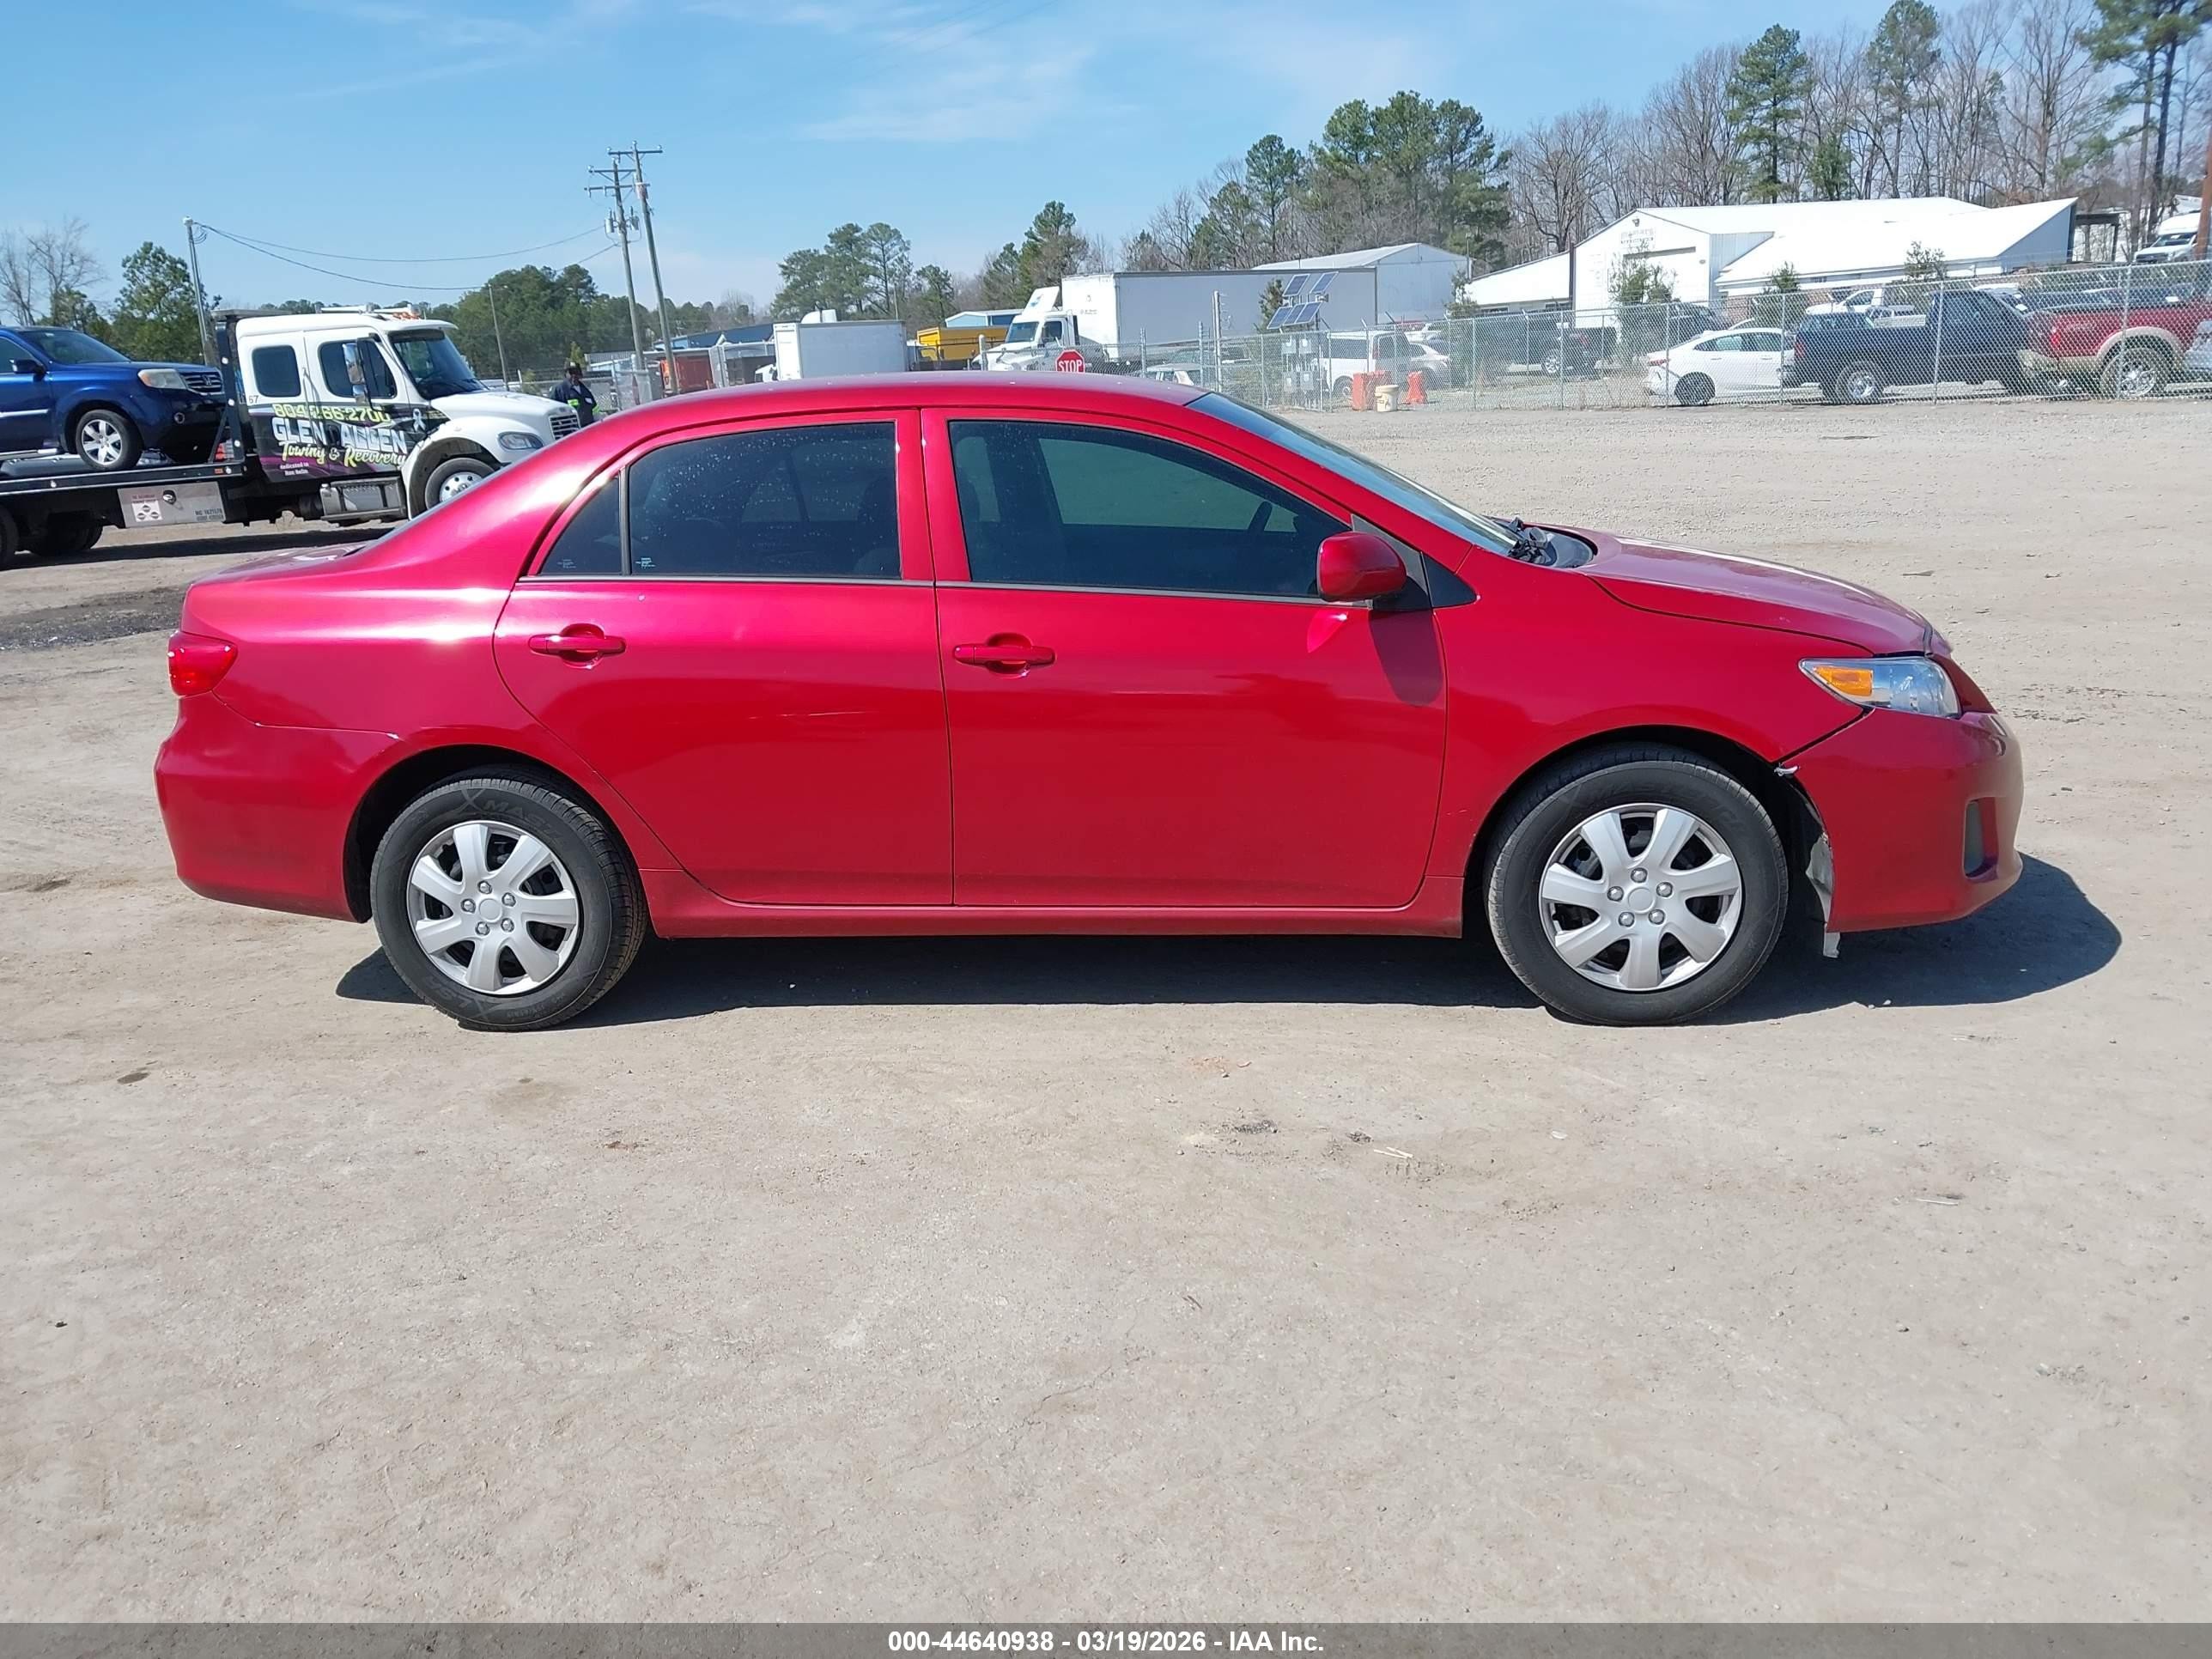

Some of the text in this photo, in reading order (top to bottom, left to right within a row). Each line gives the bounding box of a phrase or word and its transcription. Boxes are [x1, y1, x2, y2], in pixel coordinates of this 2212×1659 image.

[1058, 360, 1082, 373] STOP
[271, 416, 409, 454] GLEN ALLEN
[278, 441, 407, 471] Towing & Recovery
